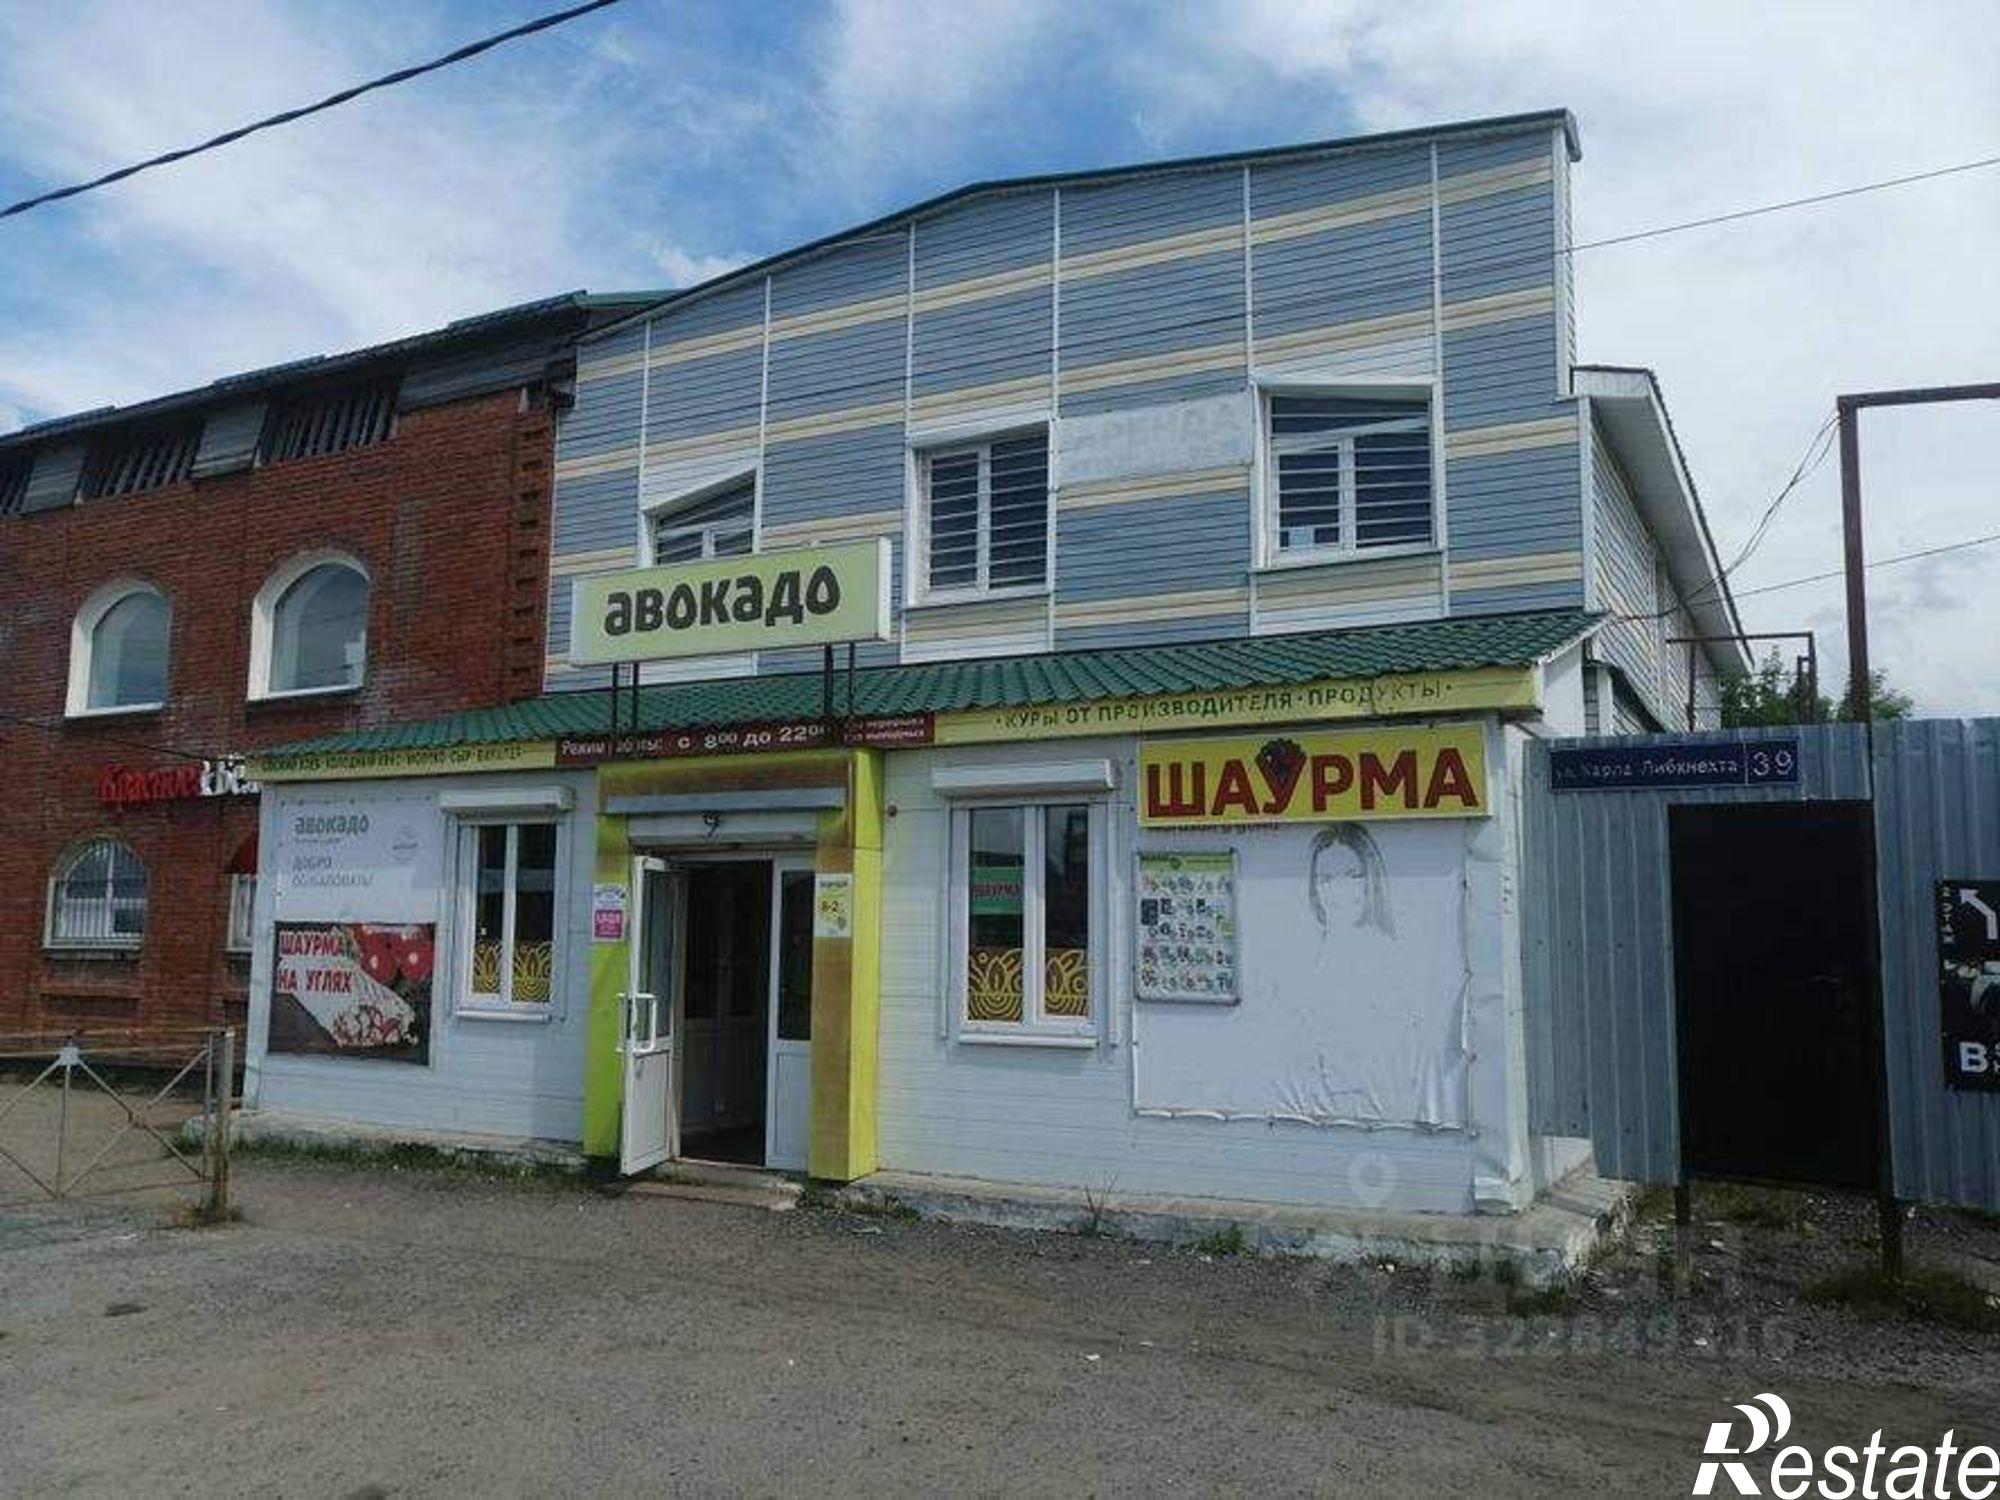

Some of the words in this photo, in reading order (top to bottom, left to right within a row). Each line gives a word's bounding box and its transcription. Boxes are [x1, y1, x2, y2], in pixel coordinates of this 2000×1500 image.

[604, 565, 841, 636] авокадо
[1006, 710, 1059, 728] КУРЫ
[1066, 706, 1091, 724] ОТ
[1098, 691, 1292, 723] ПРОИЗВОДИТЕЛЯ
[1308, 679, 1440, 708] ПРОДУКТЫ
[1146, 739, 1479, 818] ШАУРМА
[1753, 750, 1793, 777] 39
[278, 969, 298, 991] НА
